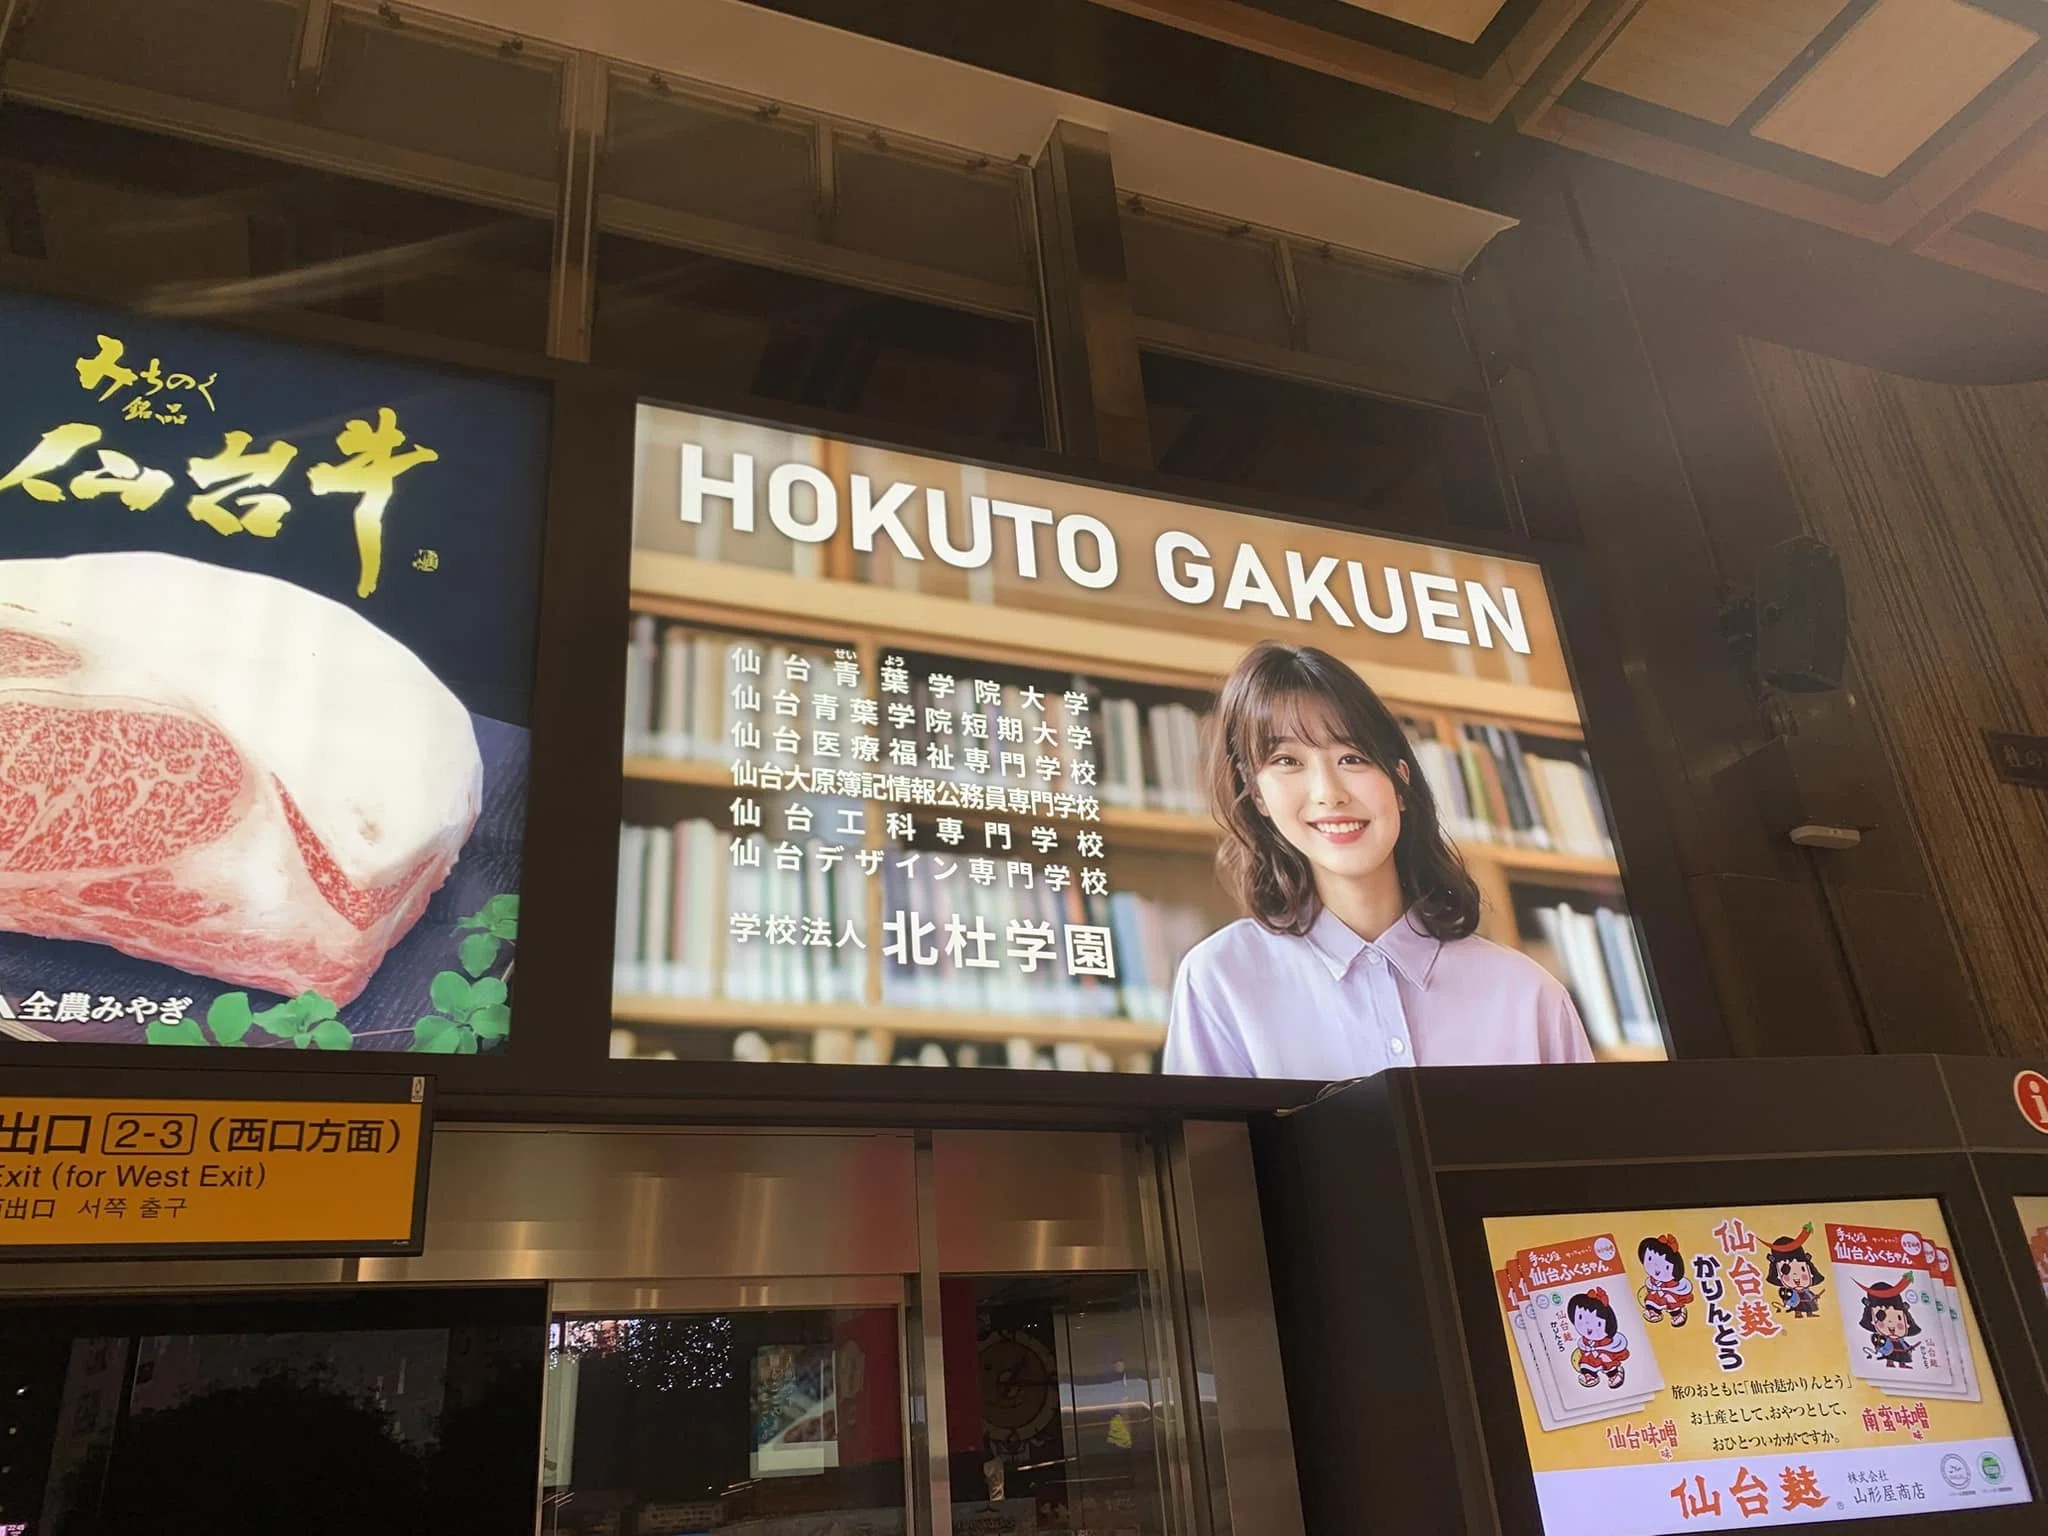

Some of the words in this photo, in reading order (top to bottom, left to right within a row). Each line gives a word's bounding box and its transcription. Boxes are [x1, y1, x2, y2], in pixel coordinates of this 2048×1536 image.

[76, 334, 217, 411] みちのく
[123, 397, 188, 425] 銘品
[0, 407, 439, 598] 仙台牛
[678, 443, 1119, 588] HOKUTO
[1155, 531, 1532, 654] GAKUEN
[731, 647, 1089, 716] 仙台青葉学院大学
[731, 684, 1092, 750] 仙台青葉学院短期大学
[731, 721, 1098, 786] 仙台医療福祉専門学校
[730, 759, 1100, 822] 仙台大原簿記情報公務員専門学校
[729, 797, 1104, 858] 仙台工科専門学校
[729, 837, 1108, 896] 仙台デザイン専門学校
[729, 911, 867, 949] 学校法人
[882, 910, 1117, 979] 北杜学園
[18, 990, 193, 1025] 全農みやぎ
[0, 1111, 92, 1155] 出口
[115, 1120, 184, 1148] 2-3
[52, 1161, 107, 1190] (for
[116, 1165, 190, 1188] West
[200, 1161, 267, 1190] Exit)
[0, 1196, 56, 1220] 出口
[77, 1197, 127, 1220] 서쪽
[139, 1197, 188, 1220] 출구
[1528, 1259, 1610, 1287] 仙台ふくちゃん
[1693, 1256, 1743, 1370] かりんとう
[1606, 1420, 1678, 1449] 仙台味噌
[1847, 1470, 1889, 1485] 株式会社
[1854, 1482, 1926, 1505] 山形屋商店
